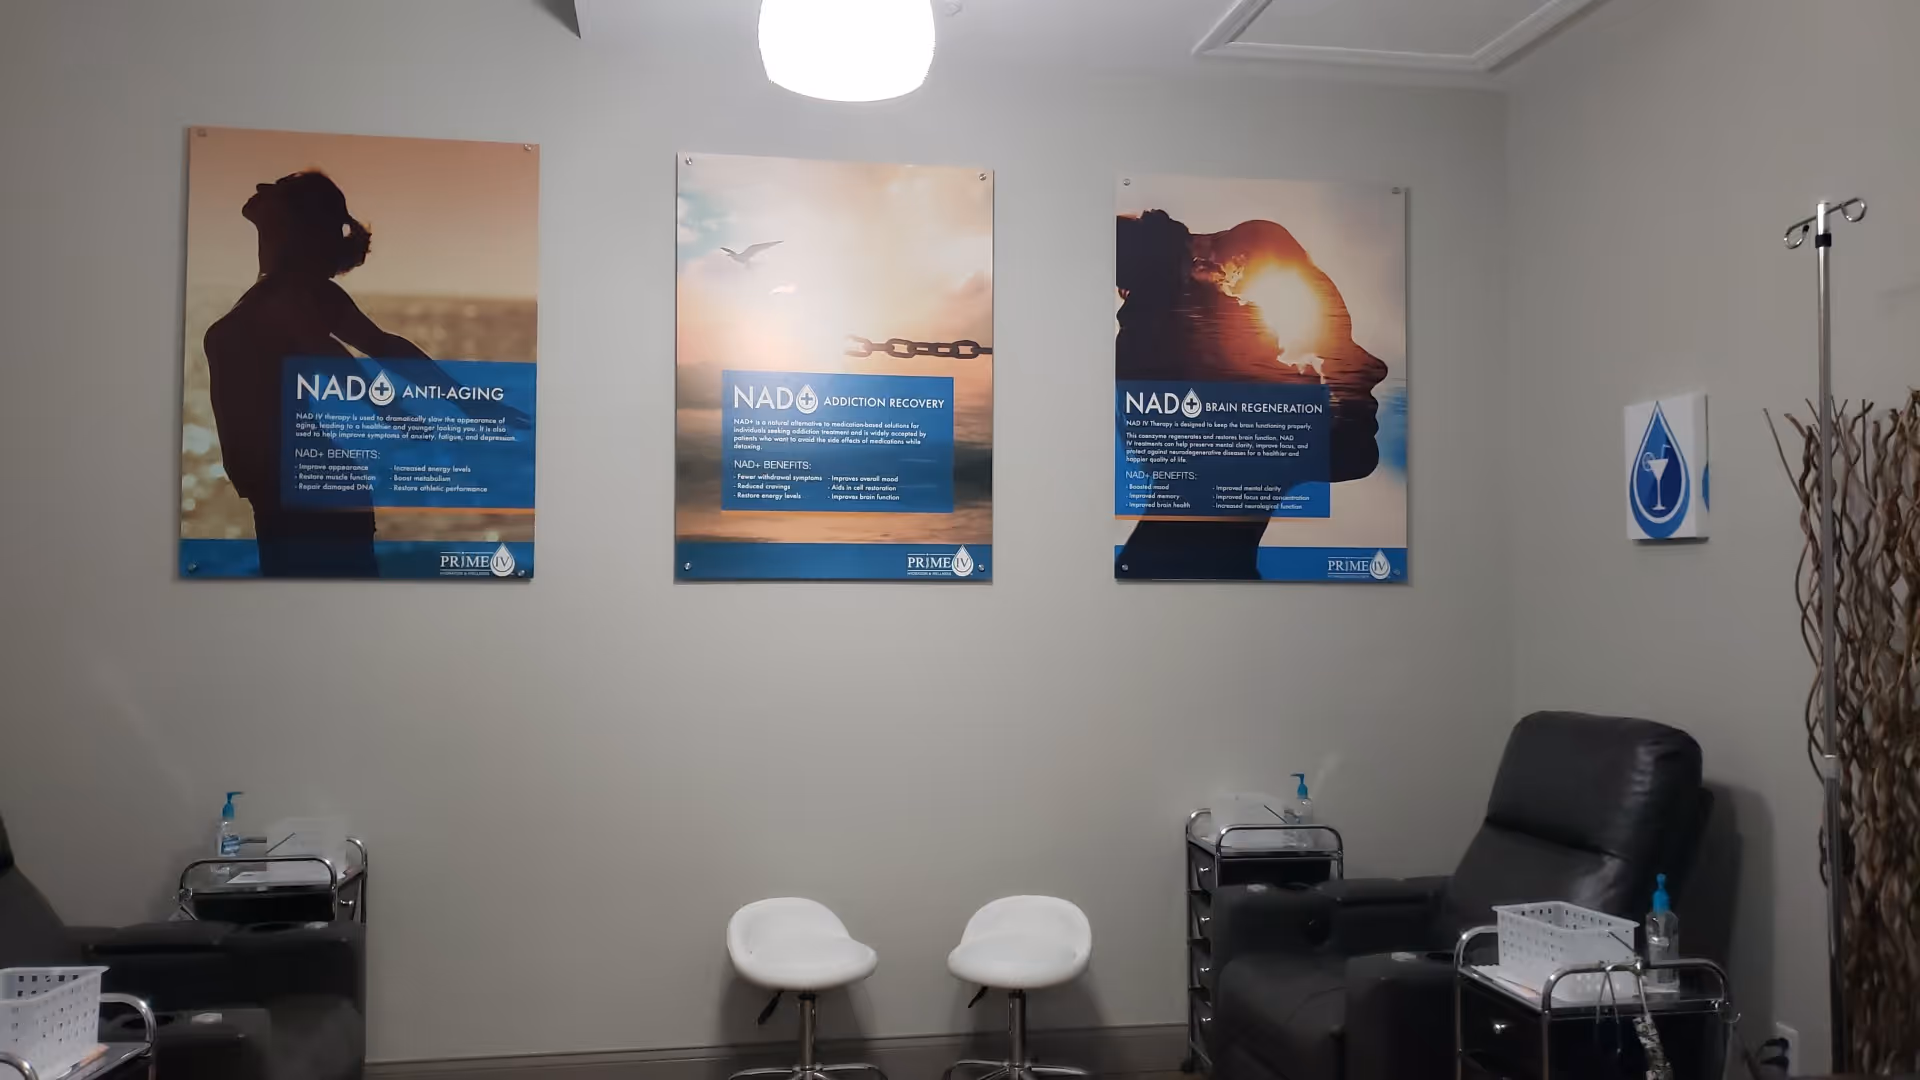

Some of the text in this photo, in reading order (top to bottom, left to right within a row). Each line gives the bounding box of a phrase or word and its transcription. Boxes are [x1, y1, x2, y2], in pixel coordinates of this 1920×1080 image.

[402, 385, 505, 401] ANTI-AGING
[824, 396, 888, 407] ADDICTION
[890, 398, 945, 409] RECOVERY
[1205, 402, 1240, 412] BRAIN
[1241, 403, 1323, 414] REGENERATION
[324, 412, 351, 422] therapy
[385, 414, 426, 424] dramatically
[456, 418, 496, 426] appearance
[318, 421, 344, 431] leading
[436, 424, 461, 434] looking
[1150, 420, 1173, 428] Therapy
[1179, 421, 1206, 429] designed
[1213, 421, 1228, 430] keep
[321, 430, 337, 440] help
[338, 430, 365, 440] improve
[366, 431, 400, 441] symptoms
[767, 427, 790, 436] seeking
[869, 429, 889, 438] widely
[890, 430, 918, 439] accepted
[1168, 433, 1201, 441] regenerates
[734, 434, 757, 443] patients
[734, 442, 763, 452] detoxing.
[1175, 441, 1188, 449] help
[1255, 442, 1278, 450] improve
[295, 448, 381, 459] NAD+ BENEFITS:
[1126, 448, 1146, 456] protect
[1147, 448, 1168, 456] against
[734, 460, 812, 470] NAD+ BENEFITS:
[1126, 456, 1148, 464] happier
[1149, 456, 1169, 464] quality
[298, 462, 369, 473] Improve appearance
[792, 474, 823, 483] symptoms
[831, 475, 858, 484] Improves
[1126, 470, 1198, 480] NAD+ BENEFITS:
[298, 482, 321, 492] Repair
[322, 483, 355, 492] damaged
[445, 484, 488, 494] performance
[765, 483, 791, 492] cravings
[1216, 484, 1242, 493] Improved
[1263, 485, 1282, 493] clarity
[831, 493, 858, 502] Improves
[1129, 492, 1156, 500] Improved
[1216, 493, 1242, 502] Improved
[1129, 501, 1155, 509] Improved
[1244, 502, 1280, 511] neurological
